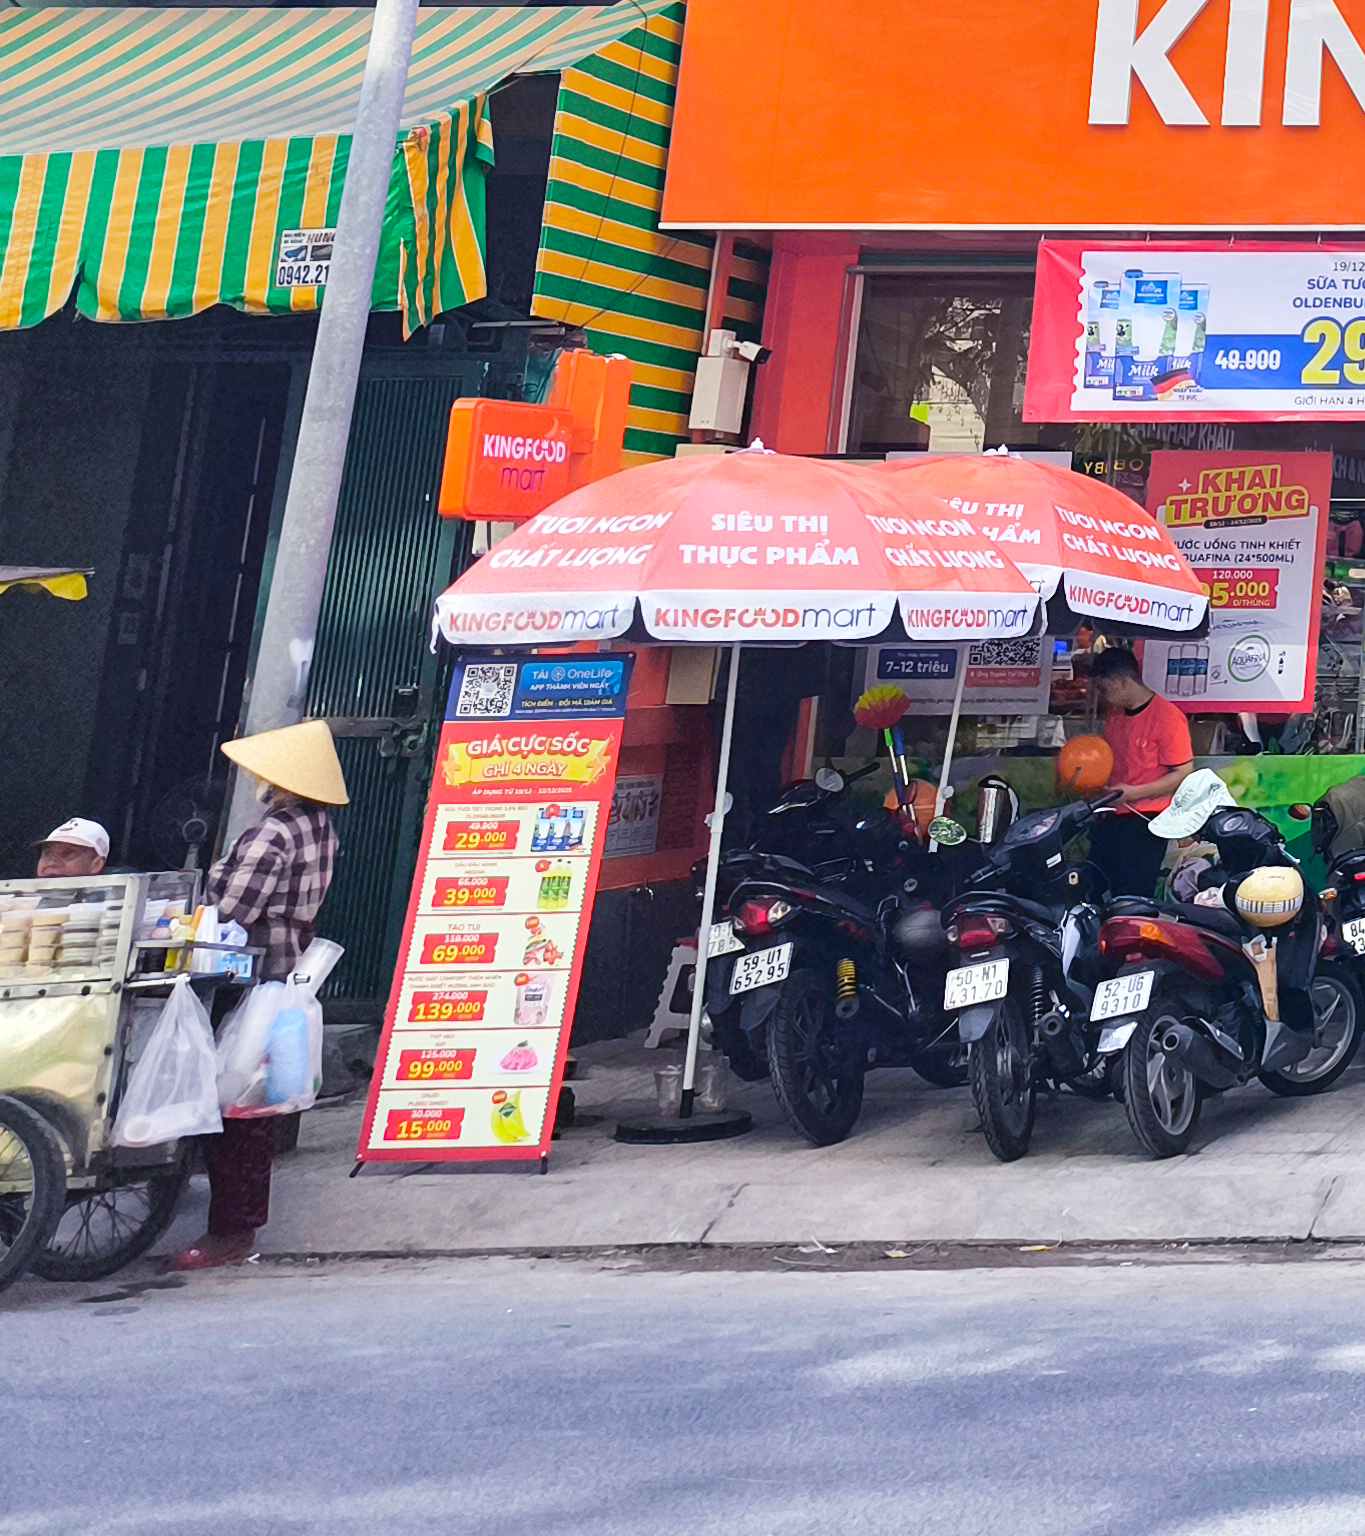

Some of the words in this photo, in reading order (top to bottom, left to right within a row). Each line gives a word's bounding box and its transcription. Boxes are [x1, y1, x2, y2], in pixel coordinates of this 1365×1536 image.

[1333, 262, 1365, 272] 19/12
[1307, 278, 1337, 290] SỮA
[1128, 364, 1159, 378] Milk
[1295, 395, 1316, 405] GIỚI
[1320, 397, 1344, 408] HẠN
[1347, 397, 1353, 405] 4
[483, 434, 566, 463] KINGFOOD
[501, 466, 545, 491] mart
[1201, 468, 1278, 493] KHAI
[984, 502, 1024, 521] THỊ
[1169, 489, 1306, 520] TRƯƠNG
[528, 514, 592, 534] TƯƠI
[596, 512, 672, 533] NGON
[711, 511, 773, 532] SIÊU
[780, 515, 828, 535] THỊ
[866, 513, 912, 536] TƯƠI
[914, 518, 977, 538] NGON
[1056, 504, 1100, 529] TƯƠI
[1102, 519, 1160, 541] NGON
[679, 544, 757, 568] THỰC
[766, 539, 859, 566] PHẨM
[1063, 532, 1112, 557] CHẤT
[1115, 545, 1180, 571] LƯỢNG
[1205, 537, 1236, 549] UỐNG
[1240, 541, 1266, 549] TINH
[1269, 538, 1301, 549] KHIẾT
[490, 541, 557, 568] CHẤT
[559, 545, 654, 570] LƯỢNG
[884, 542, 932, 566] CHẤT
[941, 548, 1004, 571] LƯỢNG
[1213, 570, 1253, 579] 120.000
[532, 670, 549, 679] TẢI
[568, 669, 613, 678] OneLife
[886, 662, 914, 673] 7-12
[917, 662, 949, 676] triệu
[467, 734, 501, 755] GIÁ
[508, 734, 547, 754] CỰC
[551, 731, 590, 753] SỐC
[483, 761, 509, 777] CHỈ
[512, 763, 522, 774] 4
[524, 760, 568, 775] NGÀY
[455, 831, 506, 849] 29.000
[444, 888, 496, 905] 39.000
[432, 945, 485, 962] 69.000
[743, 948, 783, 970] 59-U1
[734, 966, 785, 991] 652.95
[1103, 976, 1144, 998] 52-U6
[948, 980, 1003, 1007] 431.70
[414, 1002, 480, 1020] 139.000
[1100, 995, 1142, 1015] 9310
[408, 1060, 462, 1078] 99.000
[397, 1120, 451, 1138] 15.000
